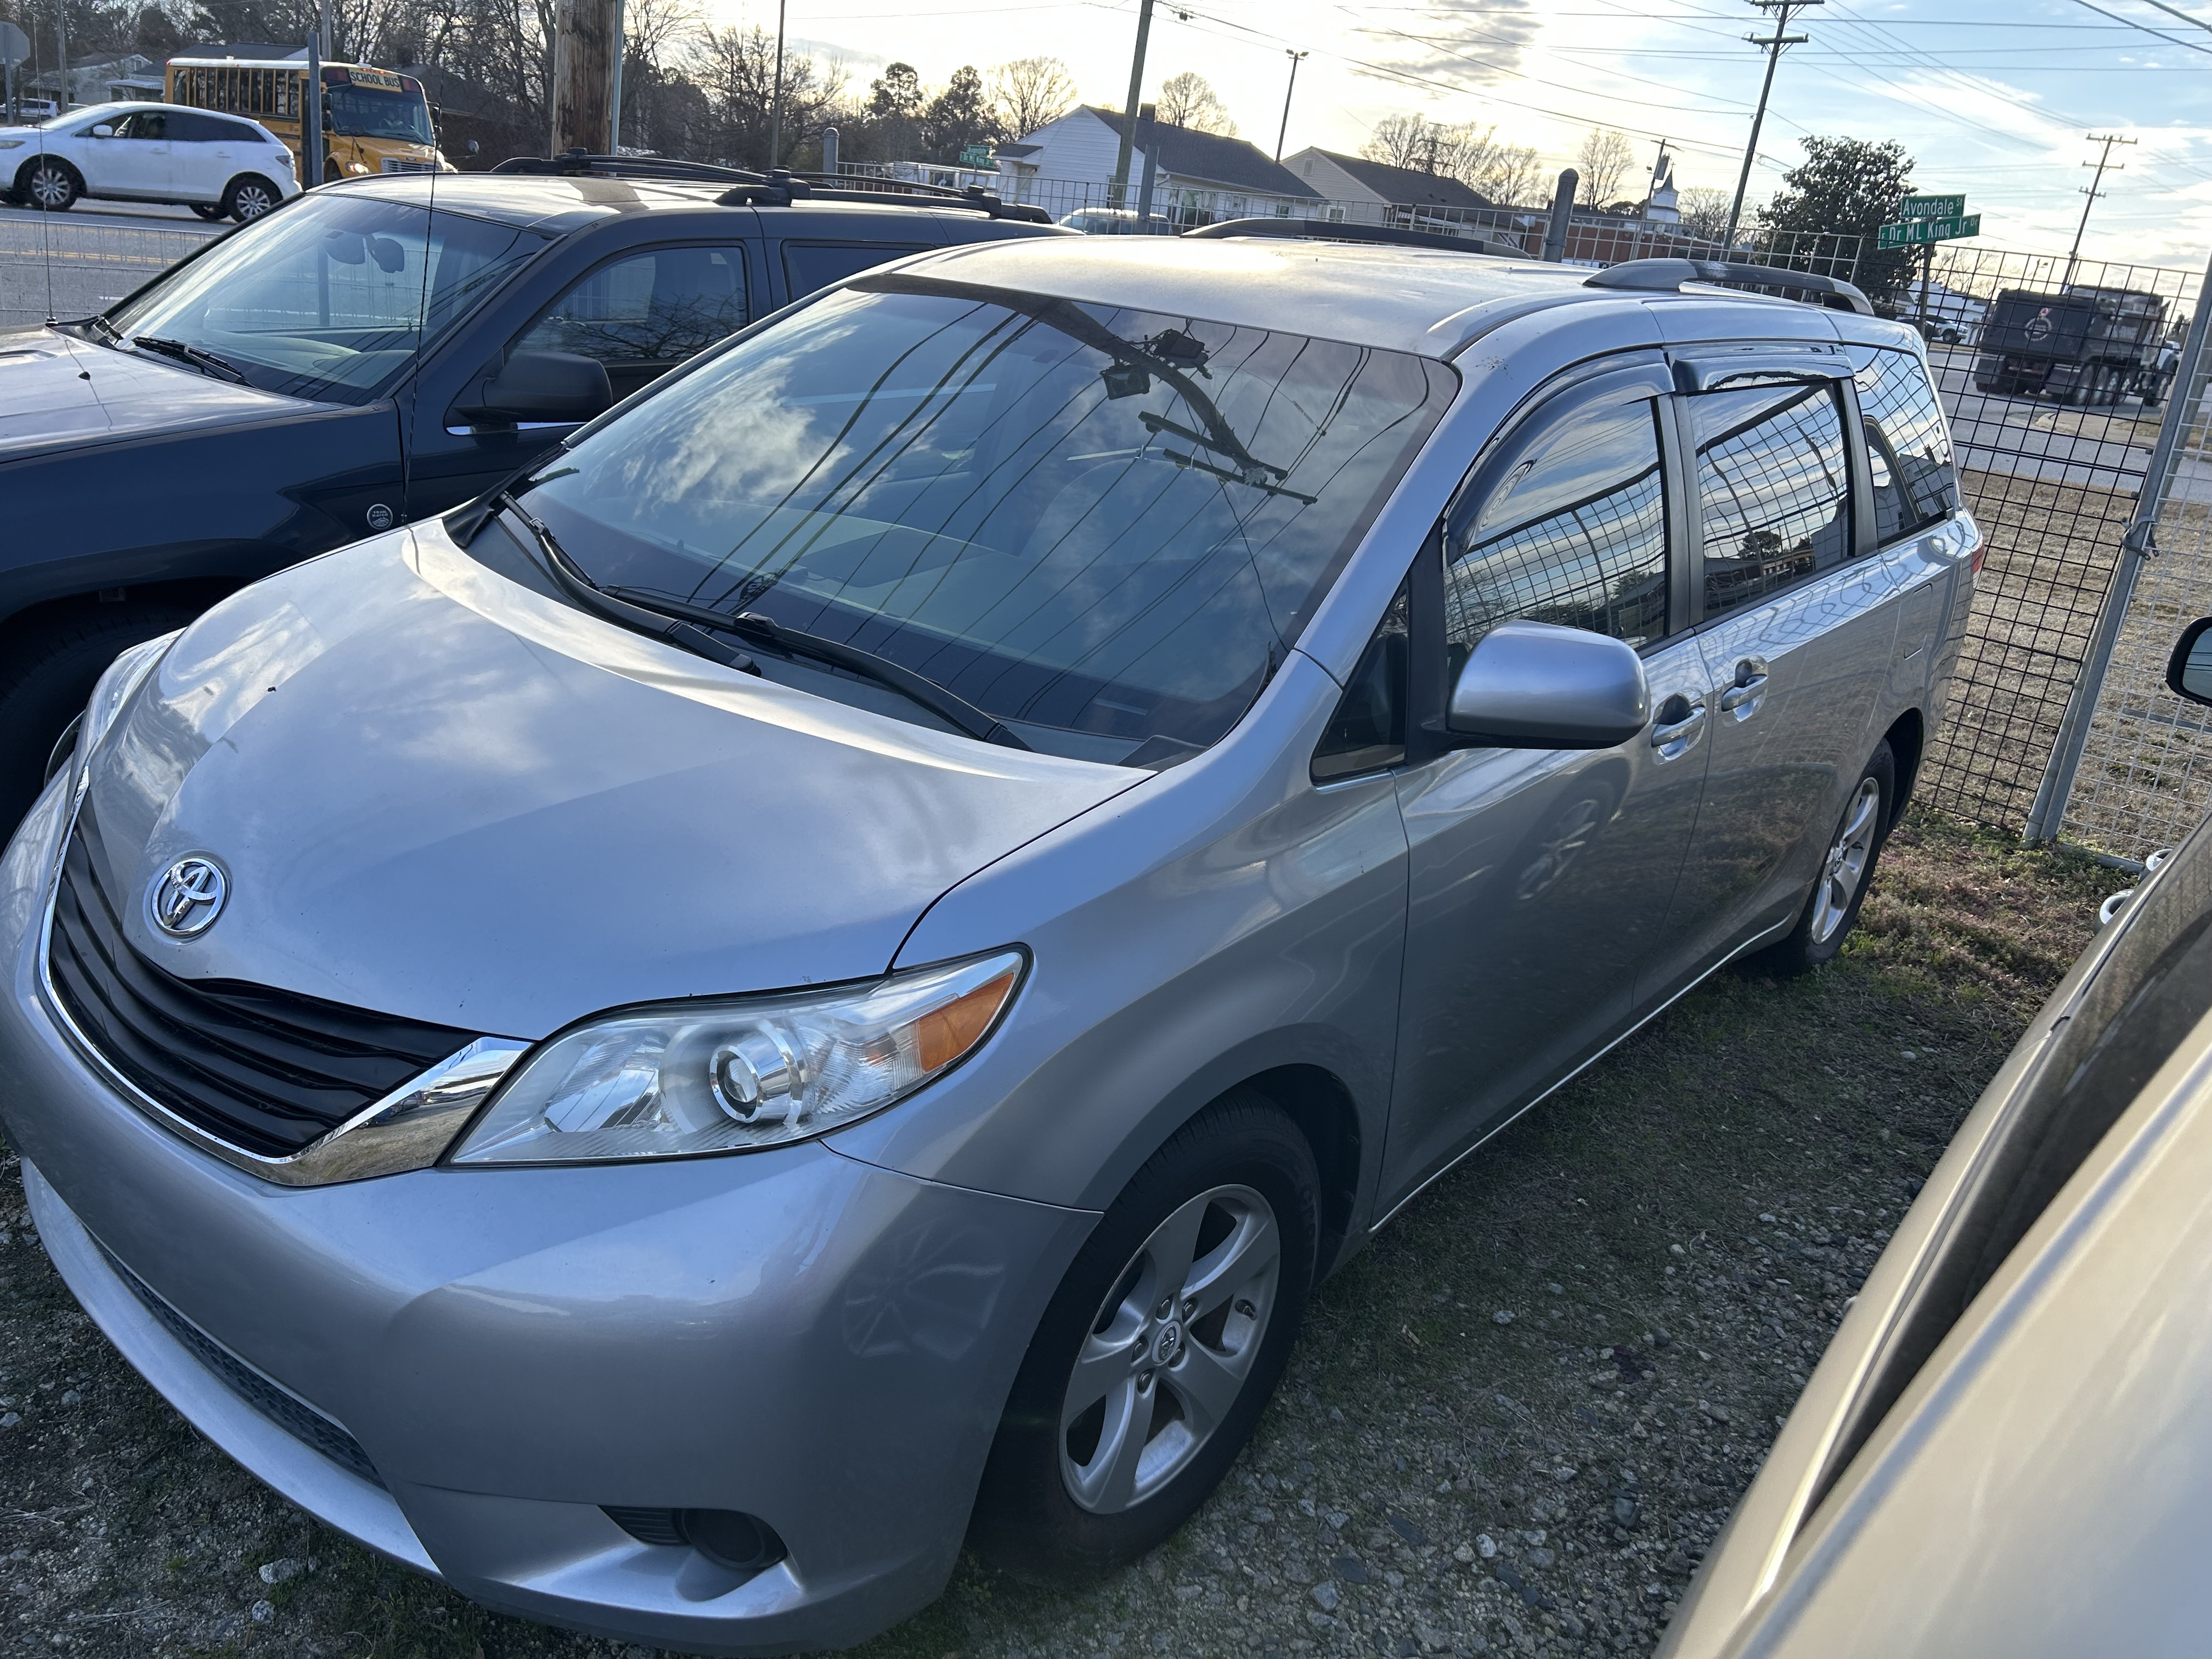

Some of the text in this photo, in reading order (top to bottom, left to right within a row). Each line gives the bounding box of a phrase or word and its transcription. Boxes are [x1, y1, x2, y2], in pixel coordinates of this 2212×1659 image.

[351, 71, 399, 87] SCHOOL BUS
[1903, 198, 1962, 216] Avondale St
[1889, 227, 1901, 243] Dr
[1906, 223, 1922, 241] ML
[1927, 221, 1951, 239] King
[1955, 217, 1967, 235] Jr
[1971, 218, 1978, 226] Dr
